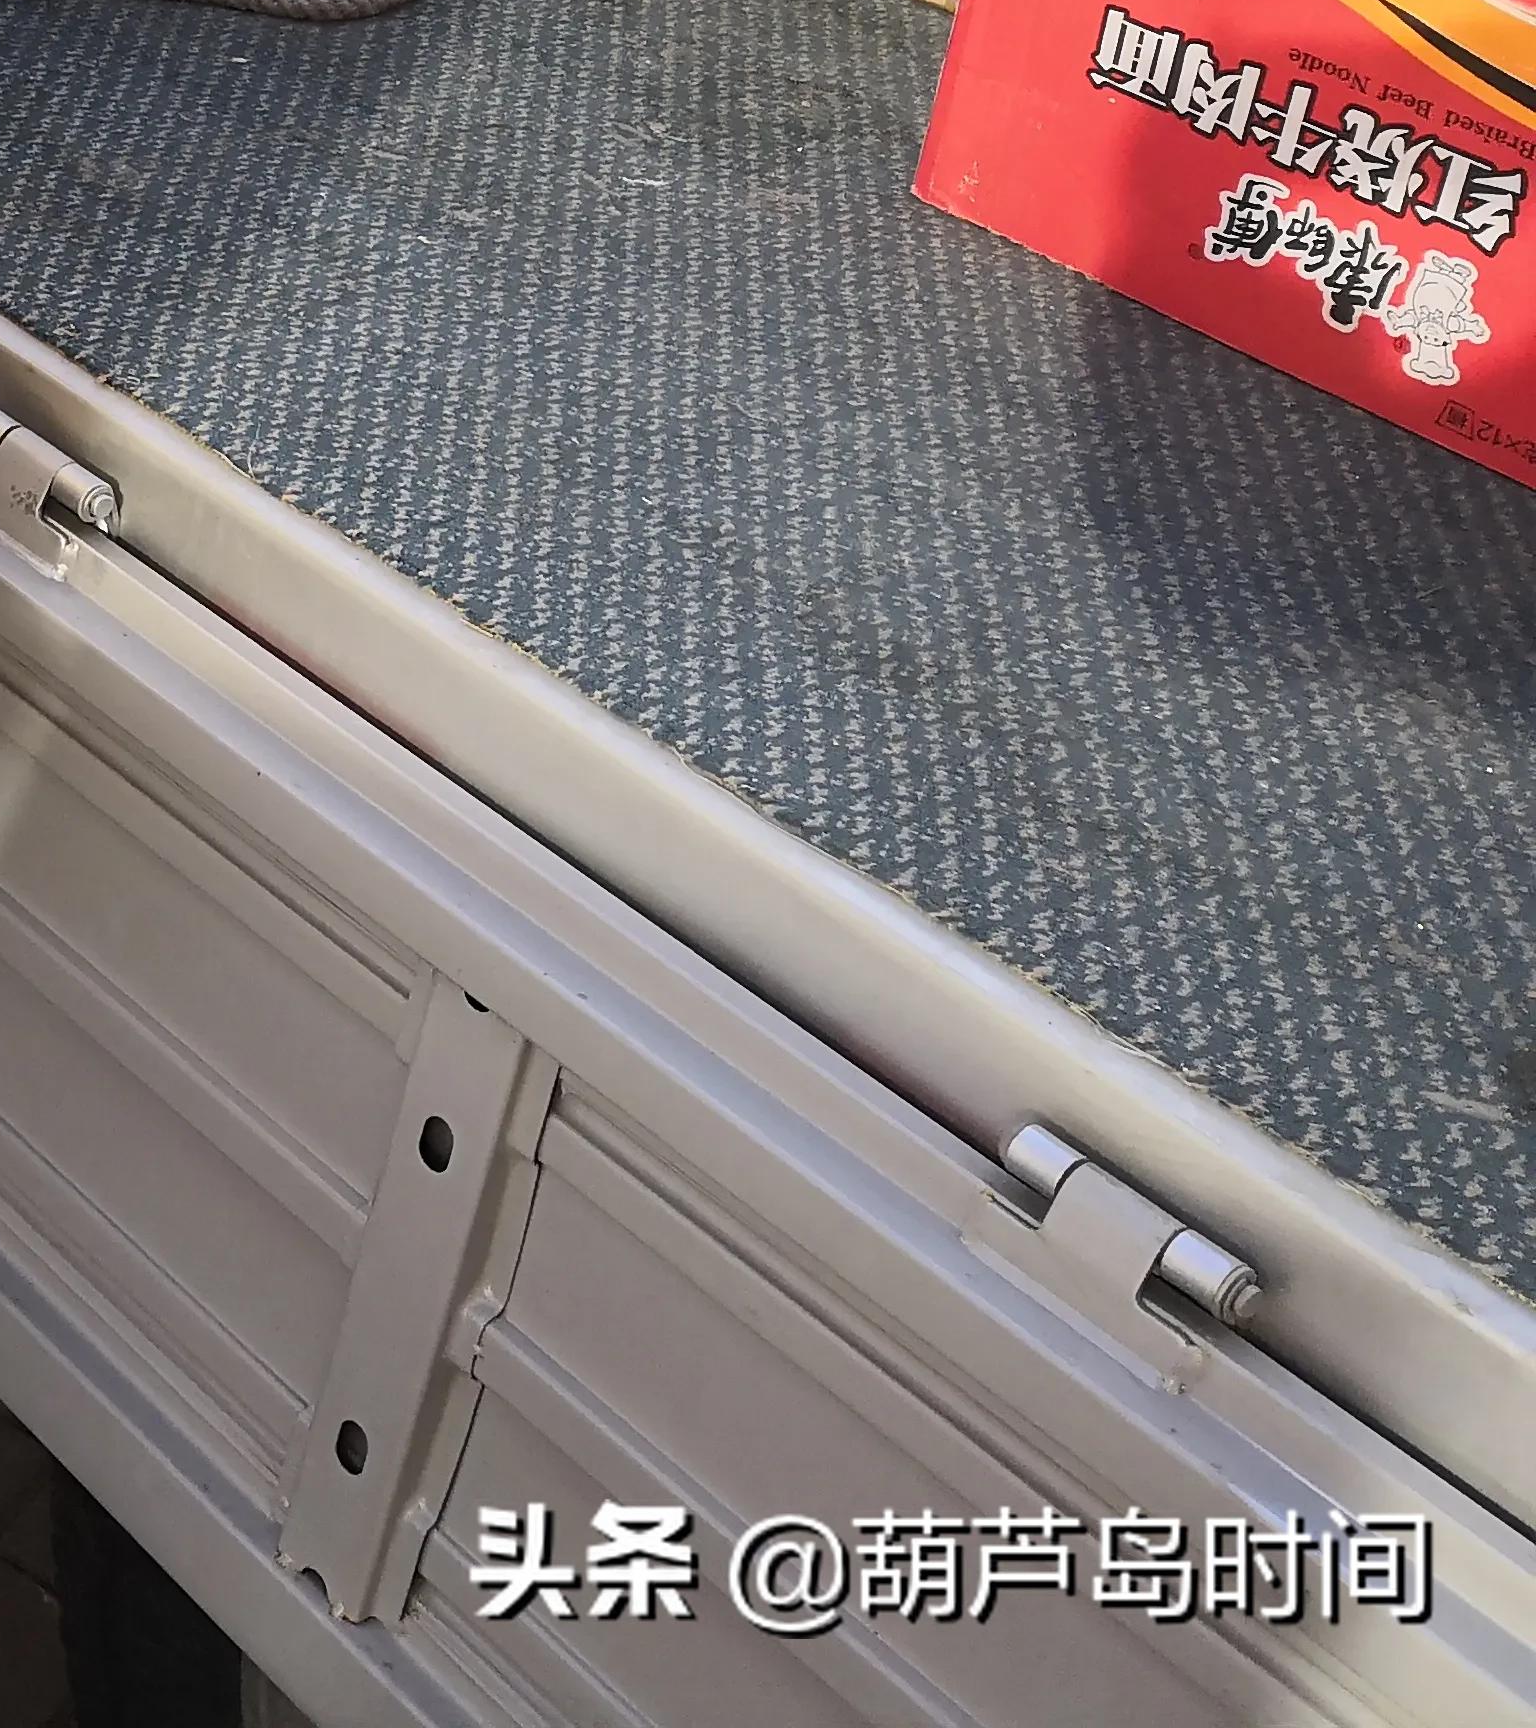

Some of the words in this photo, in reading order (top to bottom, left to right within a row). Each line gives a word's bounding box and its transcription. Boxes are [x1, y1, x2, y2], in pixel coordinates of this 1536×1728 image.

[1287, 47, 1372, 94] Noodle
[1374, 85, 1435, 119] Beef
[1090, 7, 1526, 255] 红烧牛肉面
